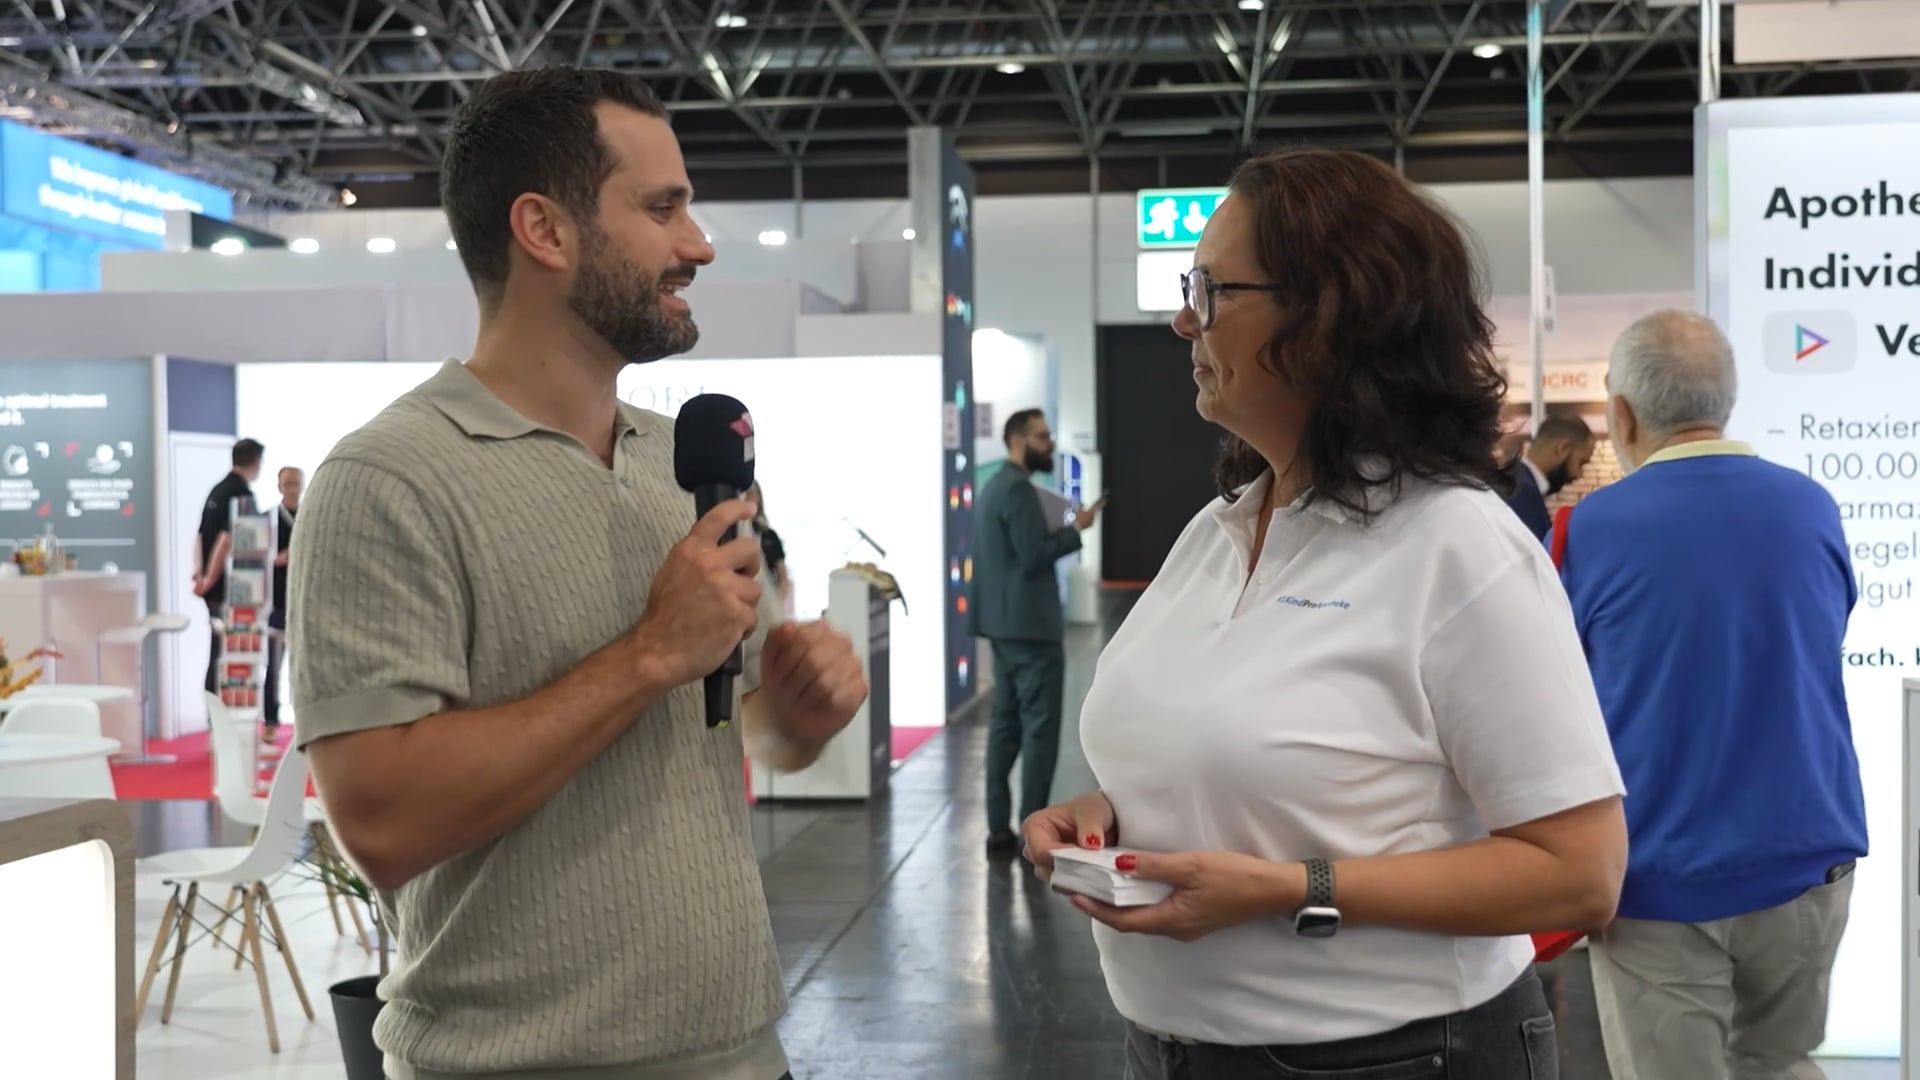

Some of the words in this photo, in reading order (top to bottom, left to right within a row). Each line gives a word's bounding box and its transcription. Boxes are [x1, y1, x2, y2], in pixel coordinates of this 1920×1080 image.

[1765, 251, 1920, 290] Individ
[1806, 452, 1920, 480] 100.00
[1840, 502, 1920, 520] arma
[1858, 571, 1912, 608] lgut
